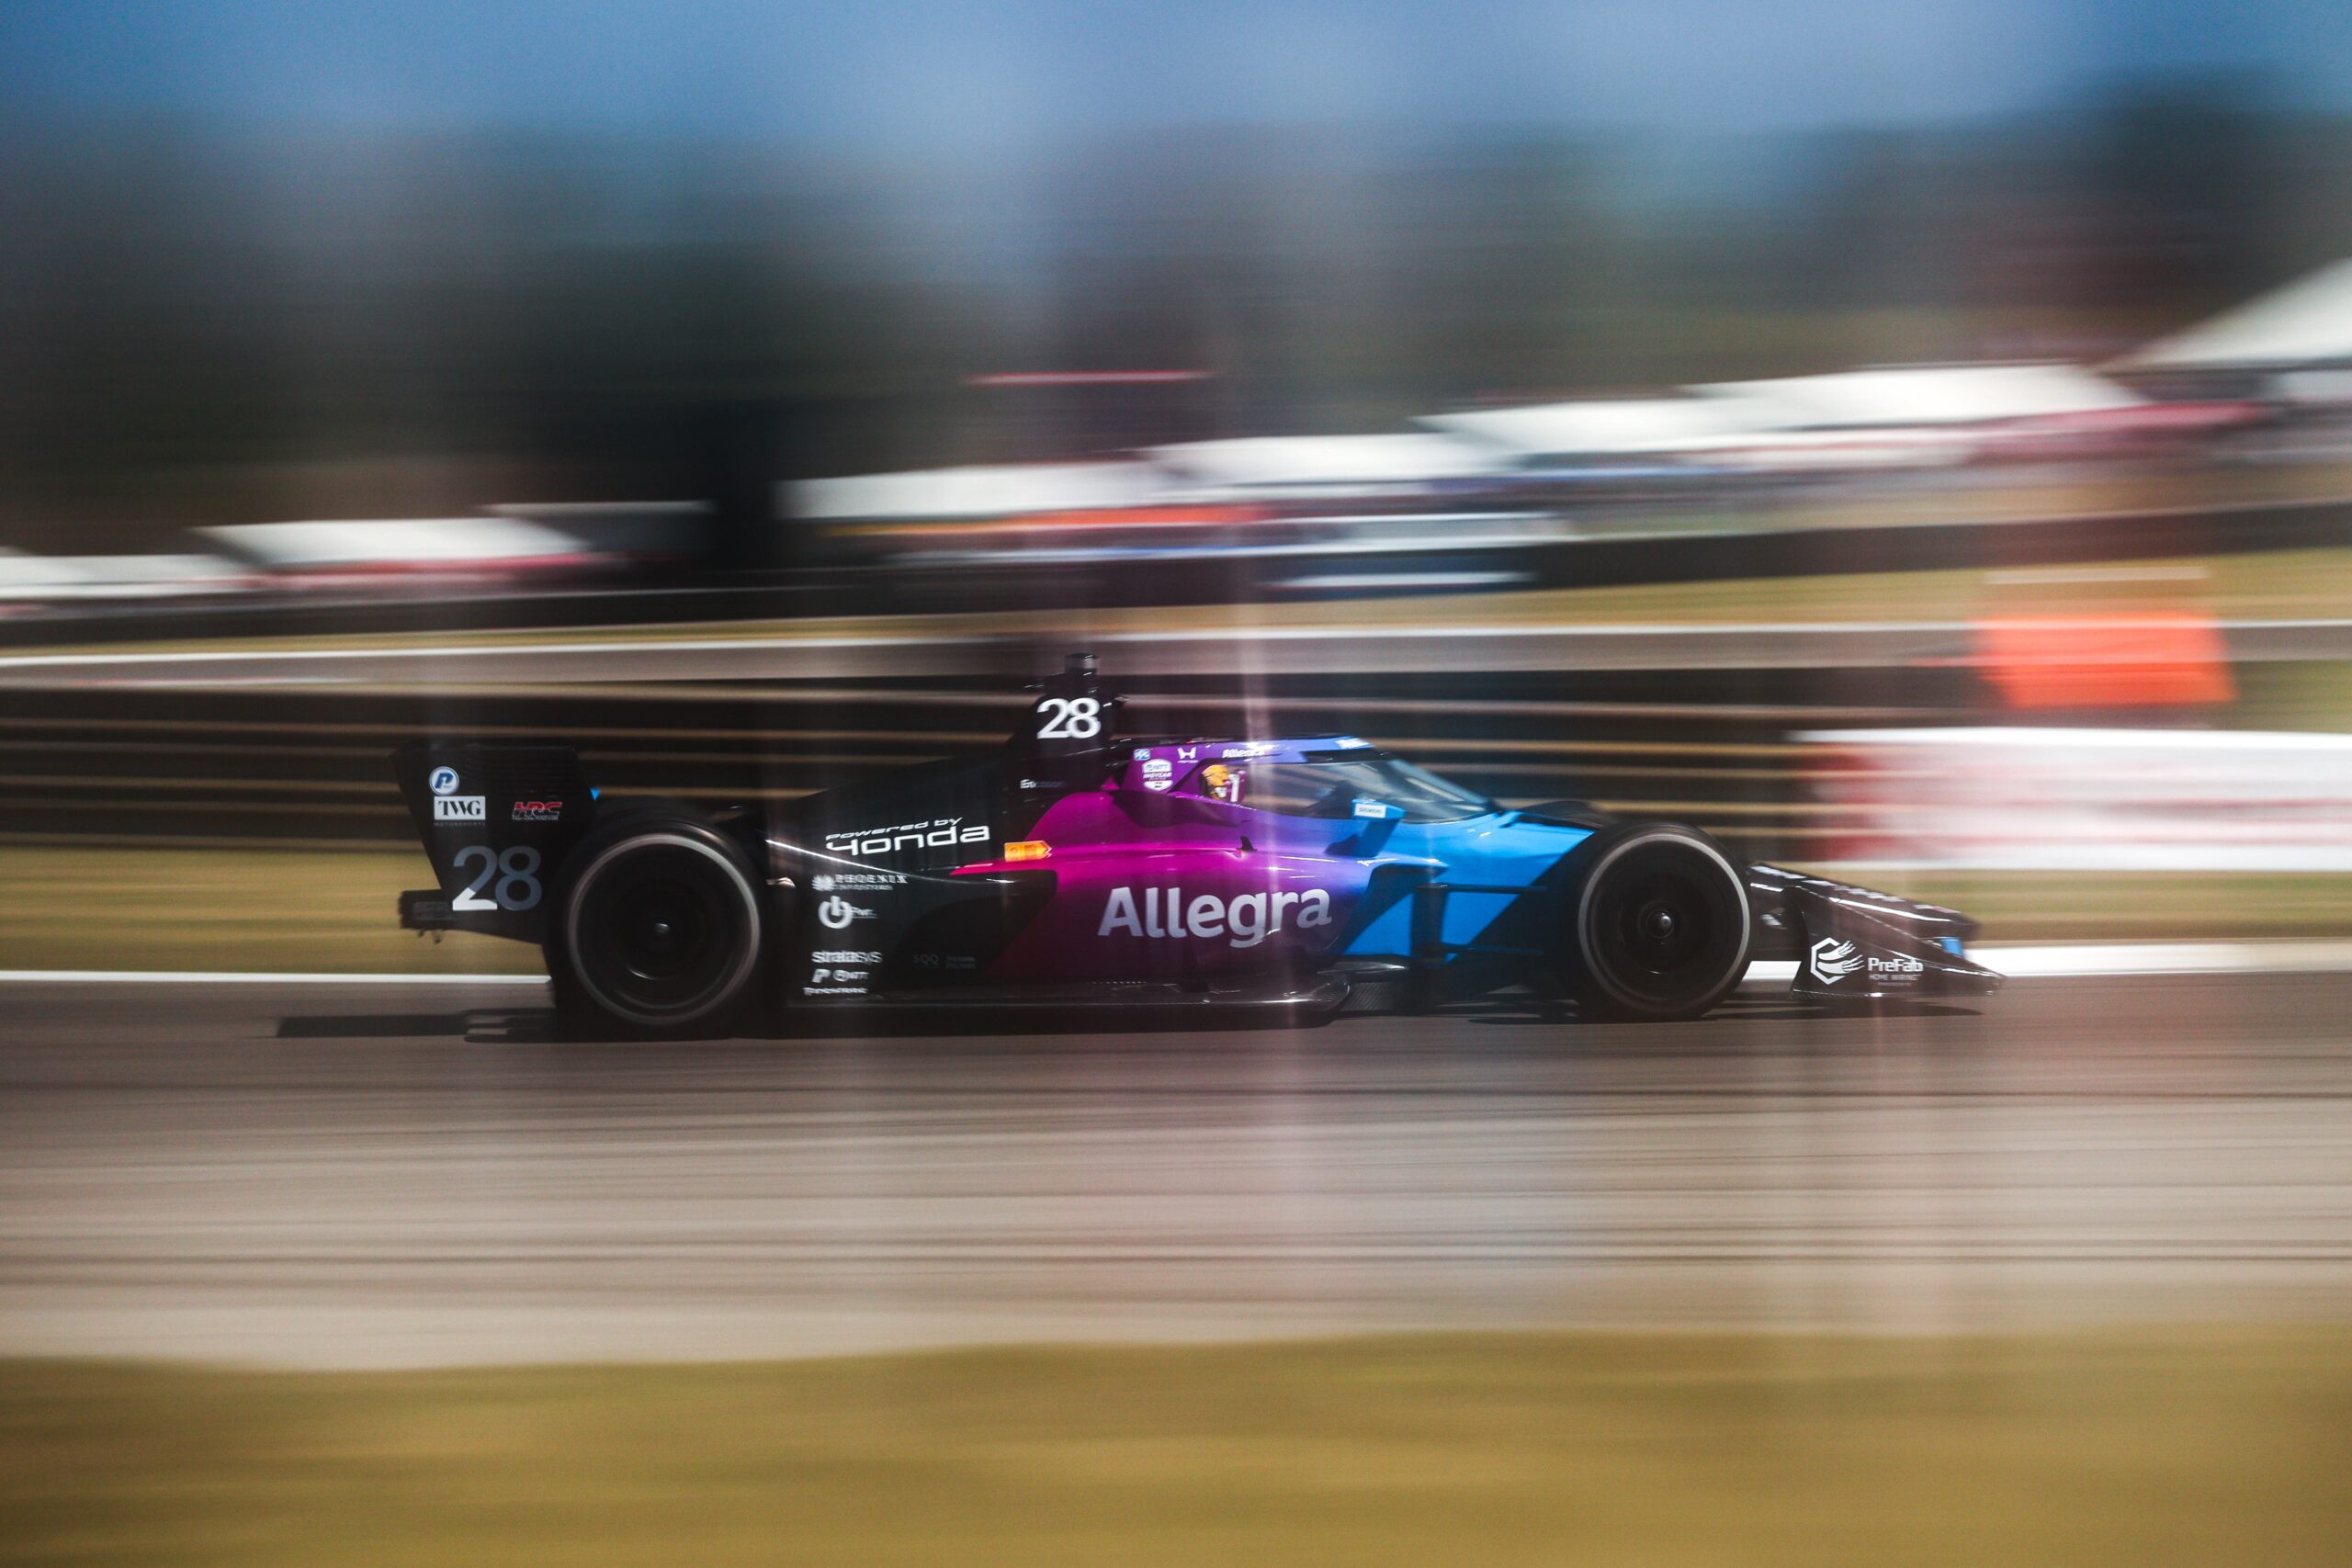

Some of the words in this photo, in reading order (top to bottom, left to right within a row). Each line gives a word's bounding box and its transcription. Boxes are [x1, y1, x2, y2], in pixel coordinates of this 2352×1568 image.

[1036, 697, 1102, 739] 28
[437, 799, 481, 817] TWG
[452, 845, 543, 911] 28
[835, 874, 909, 884] PHOENIX
[1097, 886, 1332, 949] Allegra
[1867, 958, 1924, 972] PreFab
